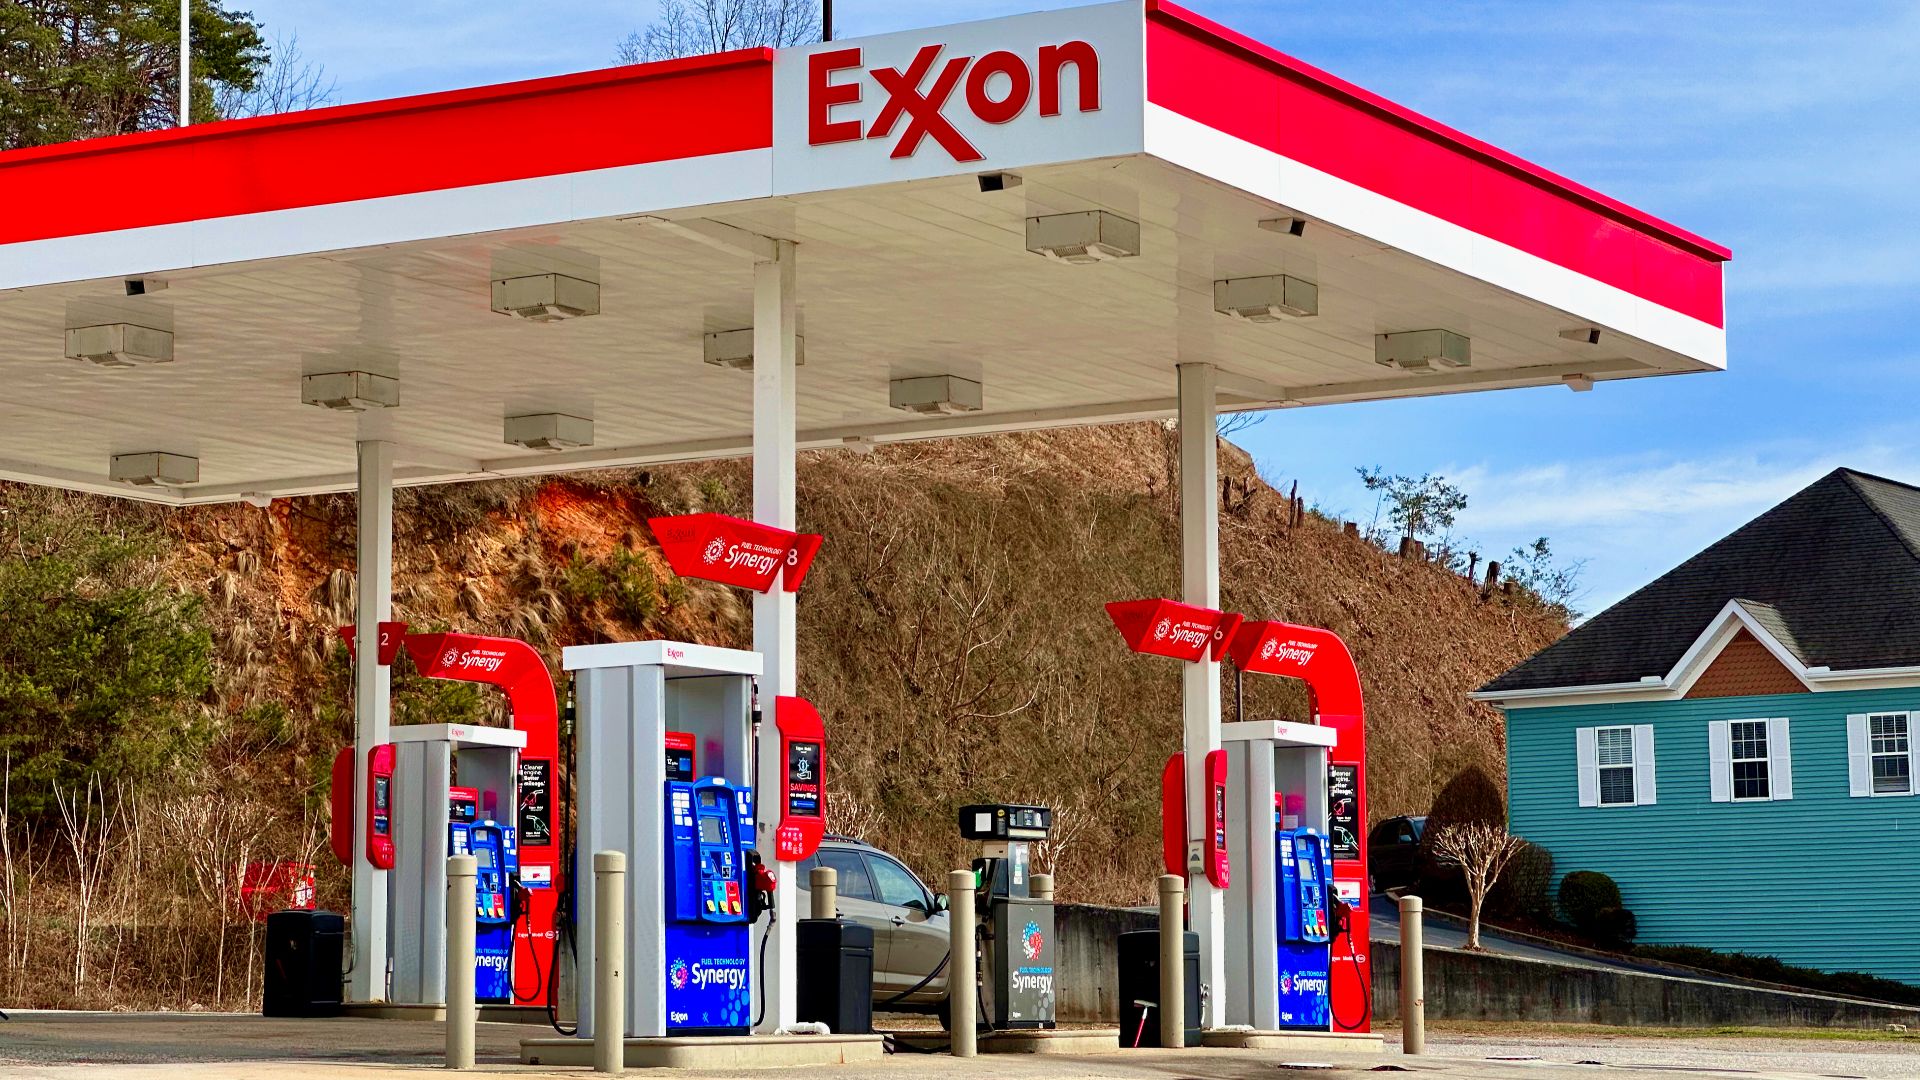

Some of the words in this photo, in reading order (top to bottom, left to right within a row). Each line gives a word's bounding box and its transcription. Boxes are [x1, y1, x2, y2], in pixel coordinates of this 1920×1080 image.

[808, 40, 1101, 162] Exxon
[740, 541, 752, 550] FUEL
[753, 544, 783, 555] TECHNOLOGY
[724, 544, 779, 575] Synergy
[786, 548, 798, 566] 8
[381, 632, 389, 646] 2
[1169, 623, 1209, 648] Synergy
[1213, 625, 1223, 640] 6
[459, 651, 503, 671] Synergy
[667, 647, 684, 660] Exxon
[1275, 642, 1315, 666] Synergy
[790, 783, 817, 793] SAVINGS
[745, 791, 752, 803] 8
[510, 830, 515, 839] 2
[475, 955, 509, 972] ynergy
[714, 958, 746, 966] TECHNOLOGY
[691, 962, 746, 990] Synergy
[1012, 970, 1052, 994] Synergy
[1293, 974, 1328, 996] Synergy
[670, 1011, 688, 1024] Exxon
